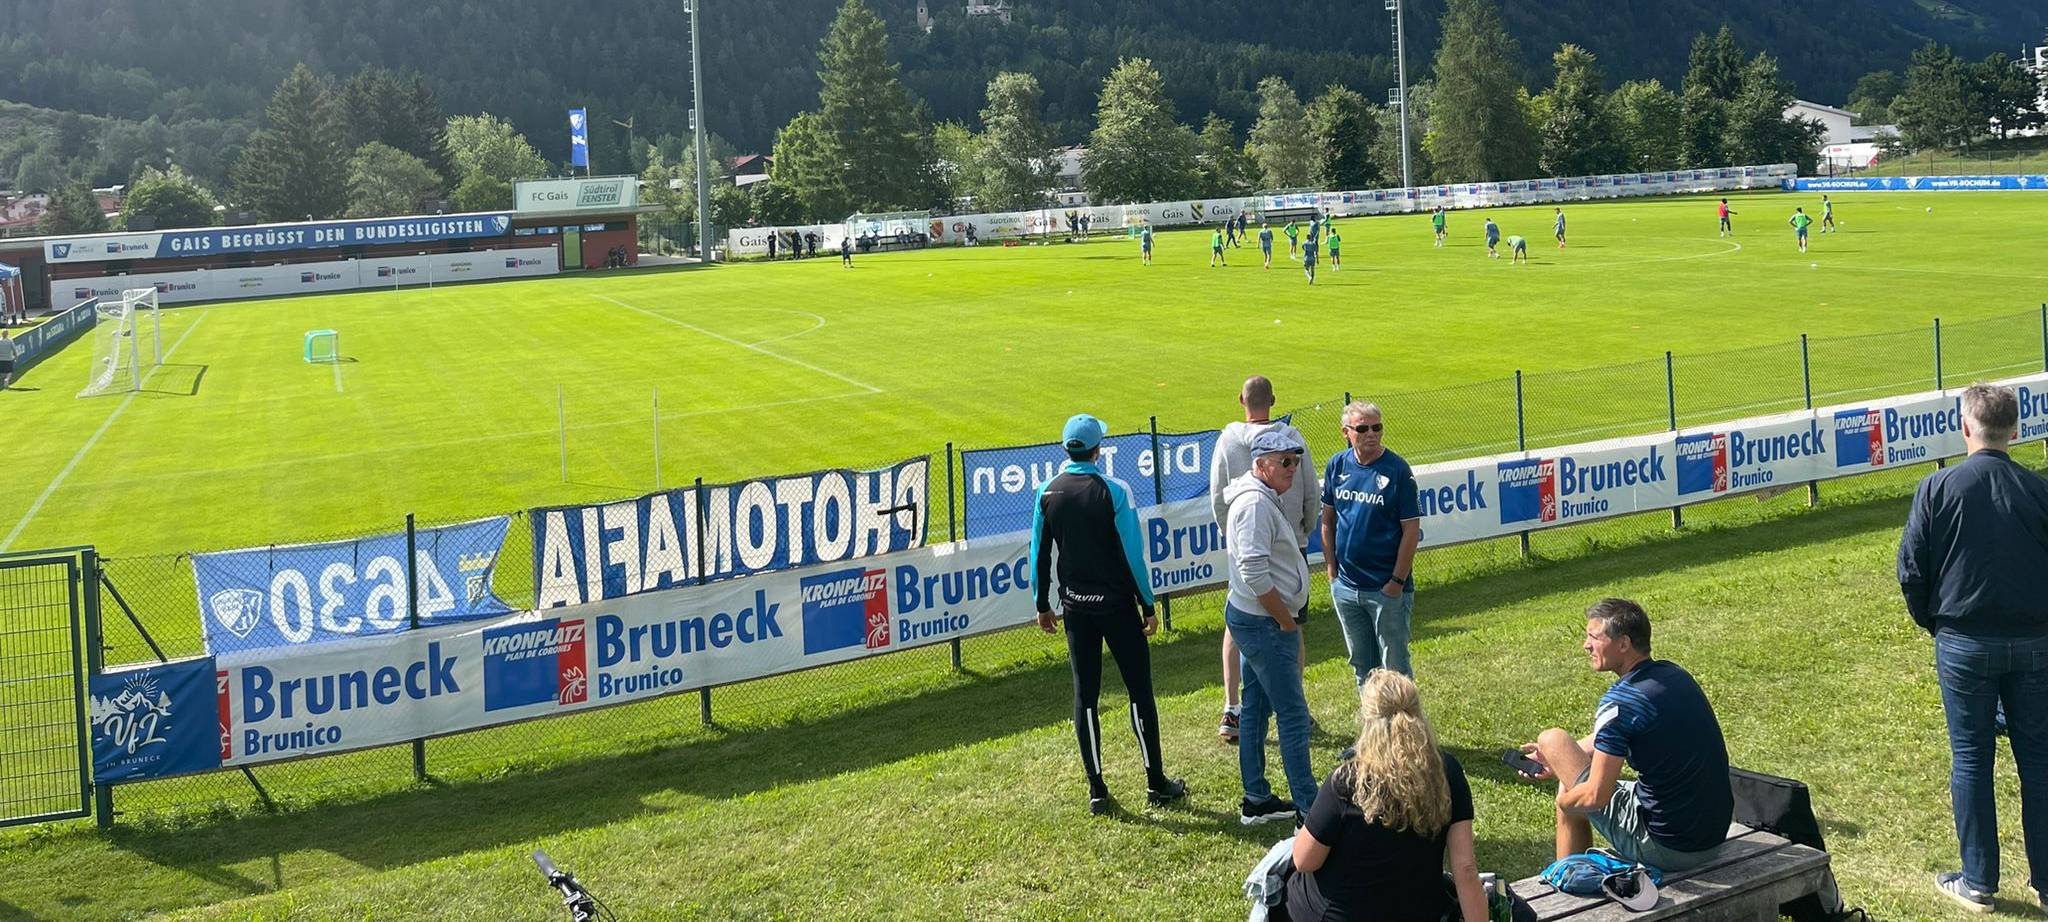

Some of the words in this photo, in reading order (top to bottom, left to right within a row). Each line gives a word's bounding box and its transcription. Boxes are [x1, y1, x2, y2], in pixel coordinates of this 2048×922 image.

[532, 192, 545, 201] FC
[547, 191, 568, 200] Gais
[581, 194, 617, 203] FENSTER
[583, 183, 618, 194] Südtirol
[1162, 209, 1184, 219] Gais
[1212, 205, 1233, 215] Gais
[171, 236, 210, 251] GAIS
[222, 229, 304, 248] BEGRÜSST
[315, 228, 345, 242] DEN
[355, 220, 483, 240] BUNDESLIGISTEN
[740, 235, 768, 248] Gais
[122, 242, 149, 252] Bruneck
[91, 288, 119, 297] Brunico
[169, 282, 196, 292] Brunico
[1835, 413, 1880, 431] KRONPLATZ
[2021, 419, 2048, 439] Bruni
[1676, 438, 1727, 457] KRONPLATZ
[1730, 418, 1826, 468] Bruneck
[1888, 443, 1926, 465] Brunico
[1499, 463, 1555, 482] KRONPLATZ
[1560, 446, 1667, 496] Bruneck
[1732, 468, 1773, 489] Brunico
[1420, 470, 1488, 516] neck
[1562, 496, 1609, 519] Brunico
[1148, 517, 1227, 563] Brun
[898, 556, 1029, 613] Brunec
[1152, 561, 1213, 589] Brunico
[801, 573, 886, 603] KRONPLATZ
[820, 598, 837, 609] PLAN
[596, 589, 783, 669] Bruneck
[900, 611, 969, 643] Brunico
[481, 623, 585, 657] KRONPLATZ
[504, 652, 525, 662] PLAN
[526, 650, 537, 658] DE
[538, 643, 572, 657] CORONES
[242, 642, 461, 723] Bruneck
[599, 665, 683, 698] Brunico
[104, 712, 167, 755] VfL
[243, 722, 342, 756] Brunico
